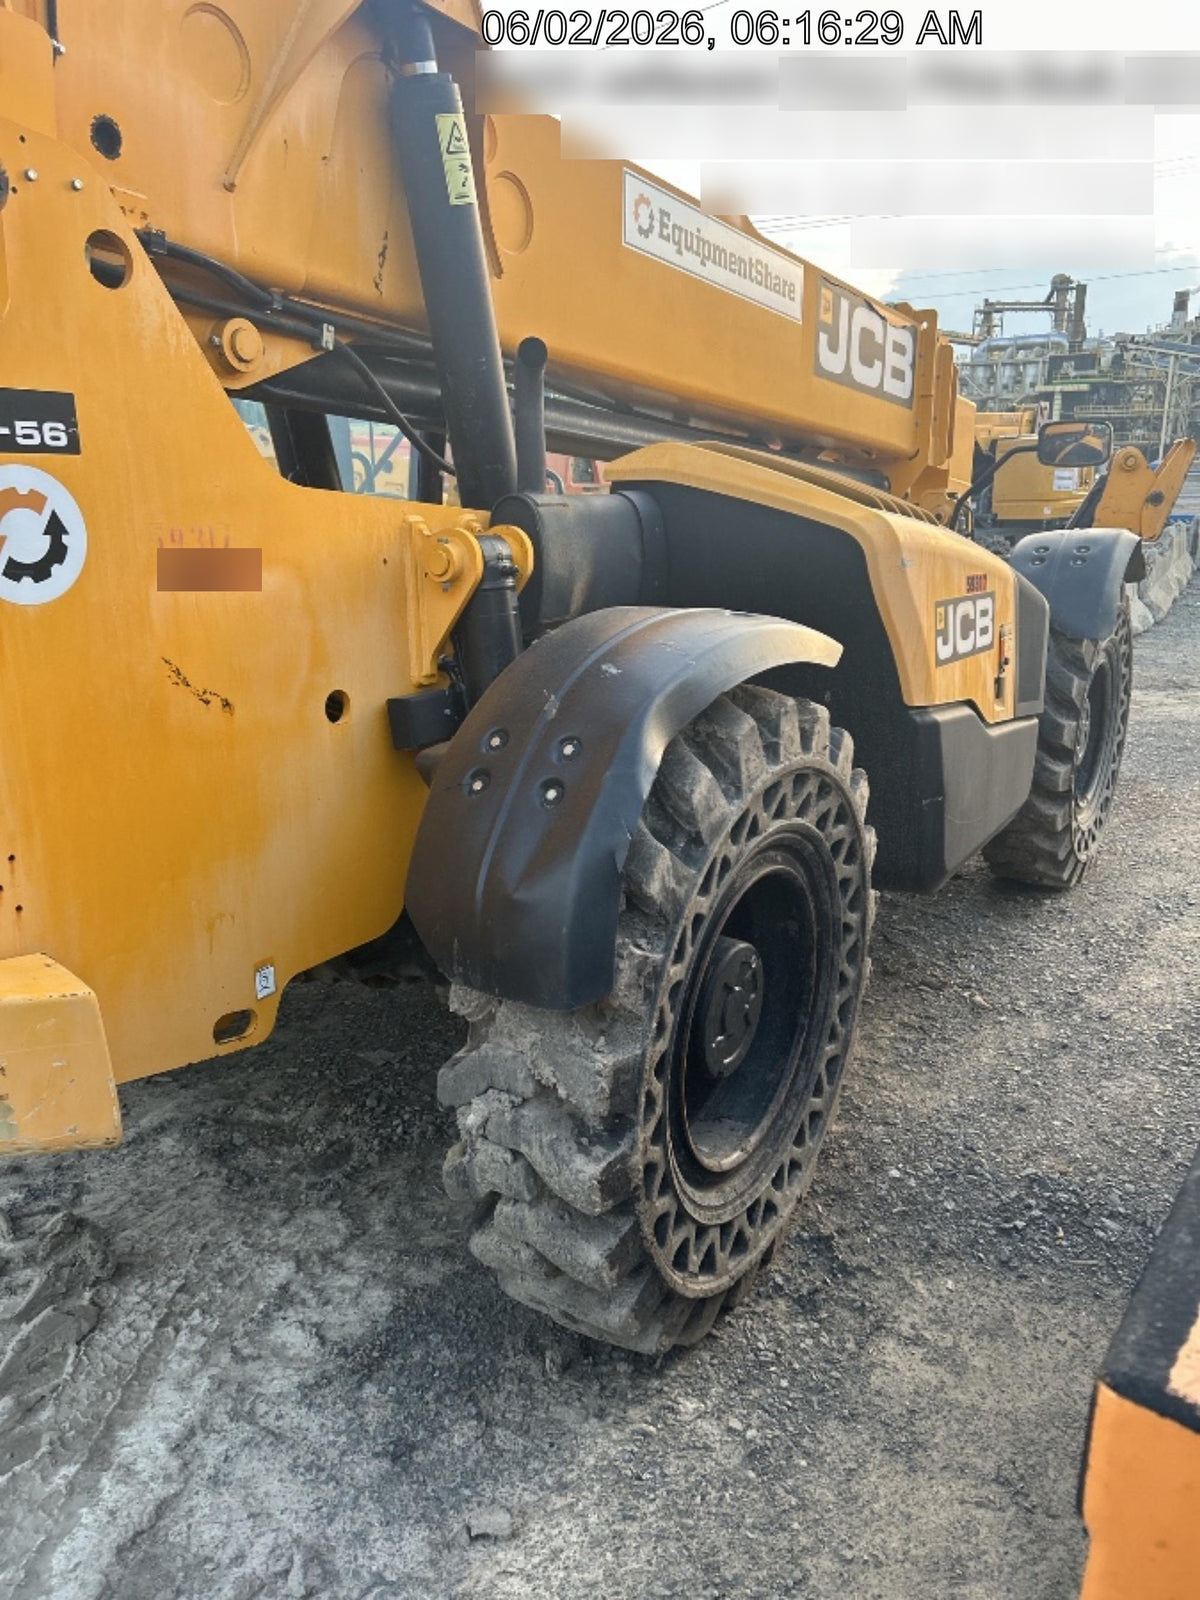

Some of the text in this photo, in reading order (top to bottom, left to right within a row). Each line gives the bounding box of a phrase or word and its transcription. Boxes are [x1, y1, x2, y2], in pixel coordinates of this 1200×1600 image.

[658, 207, 796, 302] EquipmentShare
[818, 296, 913, 399] JCB
[936, 597, 993, 660] JCB
